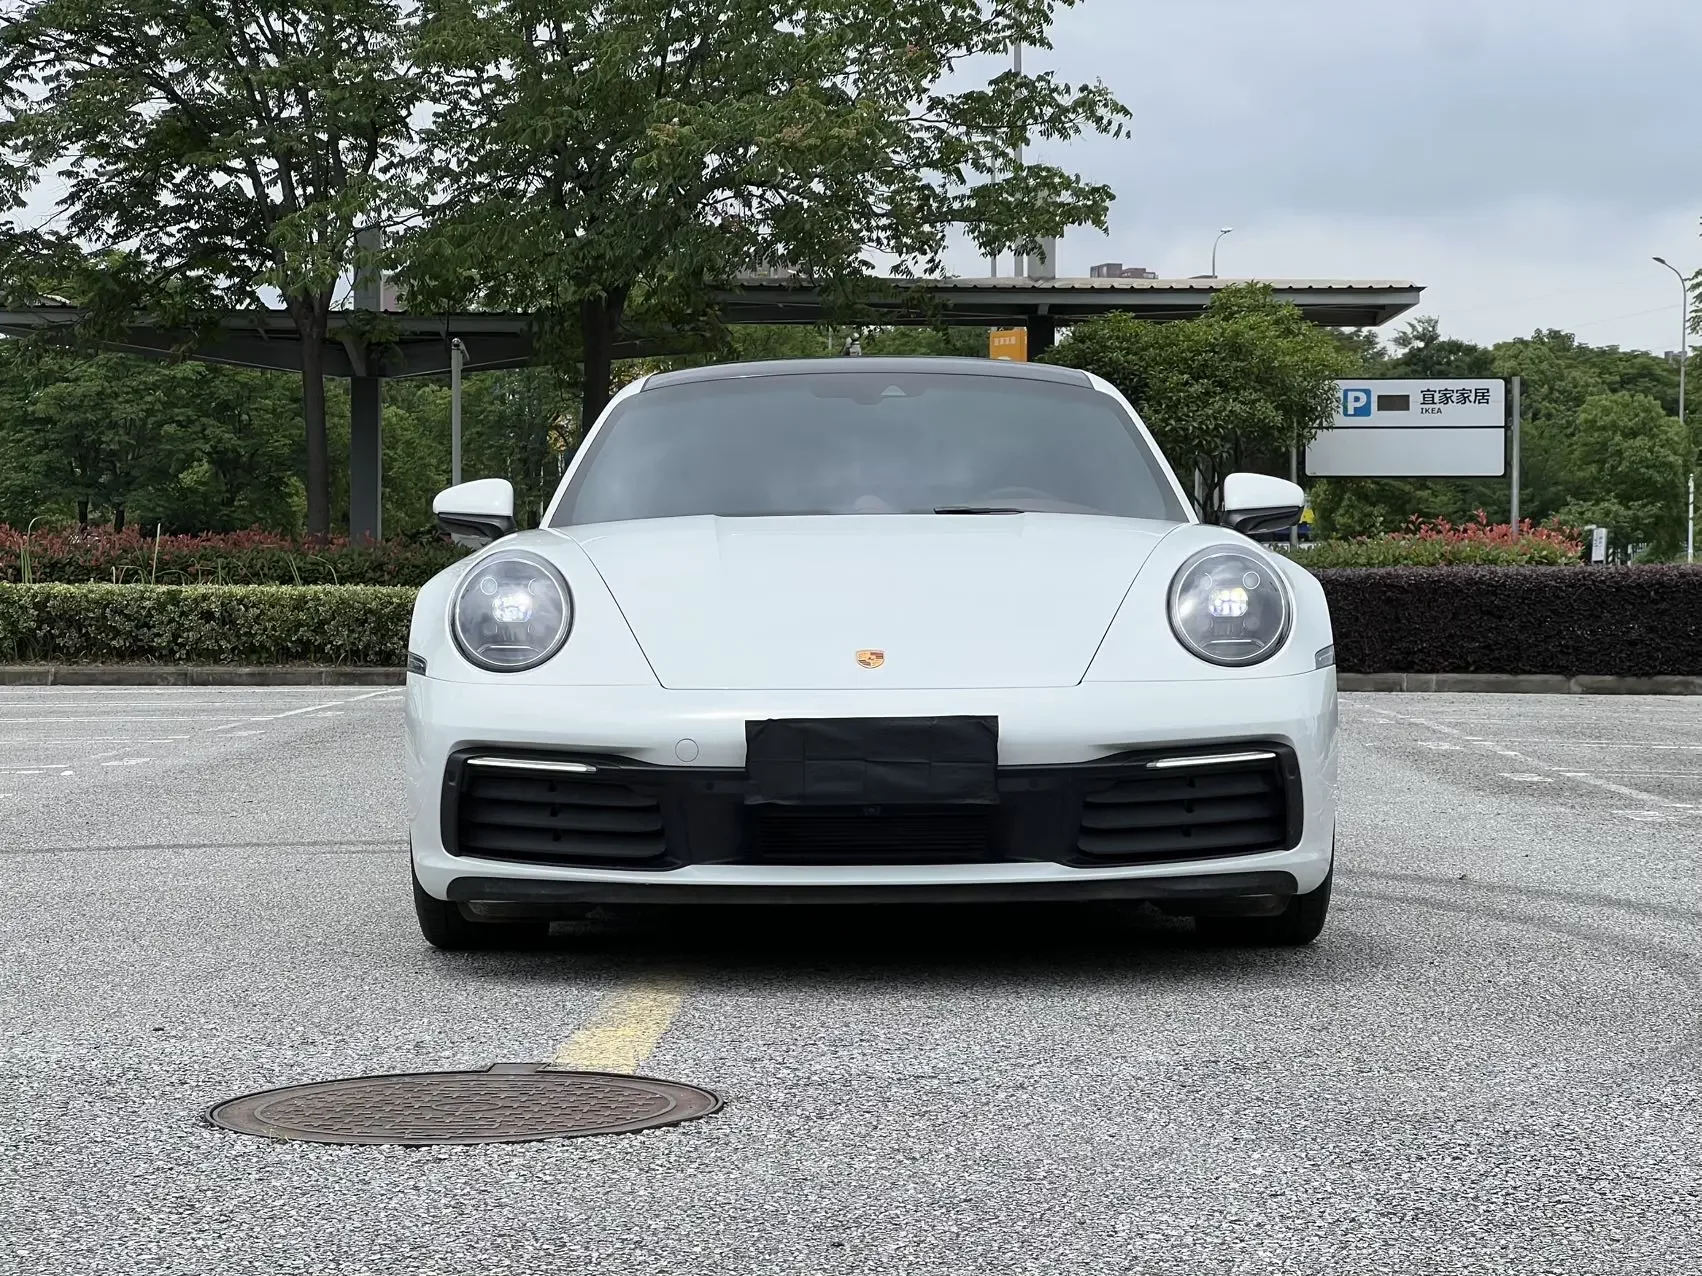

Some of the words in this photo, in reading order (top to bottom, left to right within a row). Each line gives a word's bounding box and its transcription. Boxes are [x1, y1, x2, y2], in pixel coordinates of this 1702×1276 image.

[1347, 391, 1367, 415] P
[1420, 388, 1490, 405] 宜家家居
